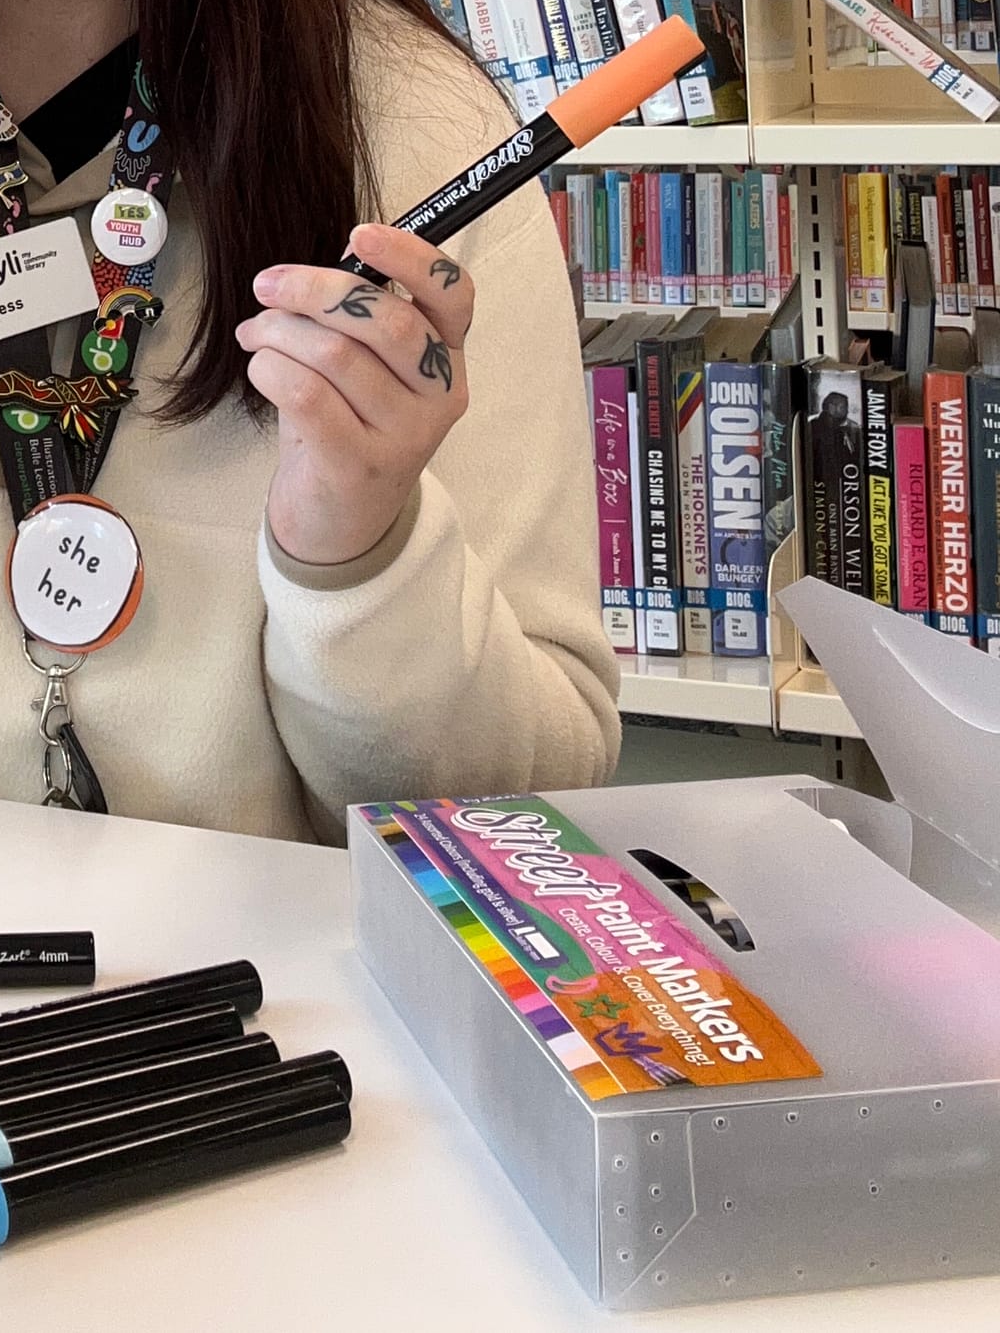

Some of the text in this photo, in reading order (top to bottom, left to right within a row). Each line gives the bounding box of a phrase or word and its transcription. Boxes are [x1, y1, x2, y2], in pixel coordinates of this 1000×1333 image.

[931, 63, 960, 91] BIOG.
[400, 128, 534, 235] Street Paint Mark
[110, 221, 139, 234] YOUTH
[118, 206, 145, 218] YES
[22, 251, 32, 259] my
[23, 250, 58, 265] community
[121, 236, 142, 246] HUB
[25, 260, 46, 272] library
[710, 381, 759, 406] JOHN
[29, 438, 47, 501] Belle Leona
[42, 436, 58, 498] Illustration
[598, 464, 628, 507] Box
[709, 407, 763, 532] OLSEN
[648, 450, 668, 574] CHASING ME TO MY
[681, 464, 693, 565] JOHN HOCKNEY
[690, 454, 707, 576] THE HOCKNEYS
[814, 481, 827, 534] SIMON
[867, 388, 891, 602] JAMIE FOXX ACT LIKE YOU GOT SOME
[909, 463, 926, 540] RICHARD
[939, 398, 968, 612] WERNER HERZO
[830, 527, 838, 550] MAN
[842, 463, 862, 590] ORSON WEL
[58, 535, 101, 574] she
[714, 563, 764, 575] DARLEEN
[37, 567, 82, 613] her
[603, 588, 631, 606] BIOG.
[647, 590, 674, 608] BIOG.
[717, 572, 762, 585] BUNGEY
[726, 590, 754, 608] BIOG.
[912, 559, 928, 608] GRAN
[939, 615, 969, 634] BIOG.
[450, 807, 764, 1063] Street Paint Markers
[39, 950, 69, 964] 4mm
[558, 906, 716, 1067] Create, Colour & Cover Everything!
